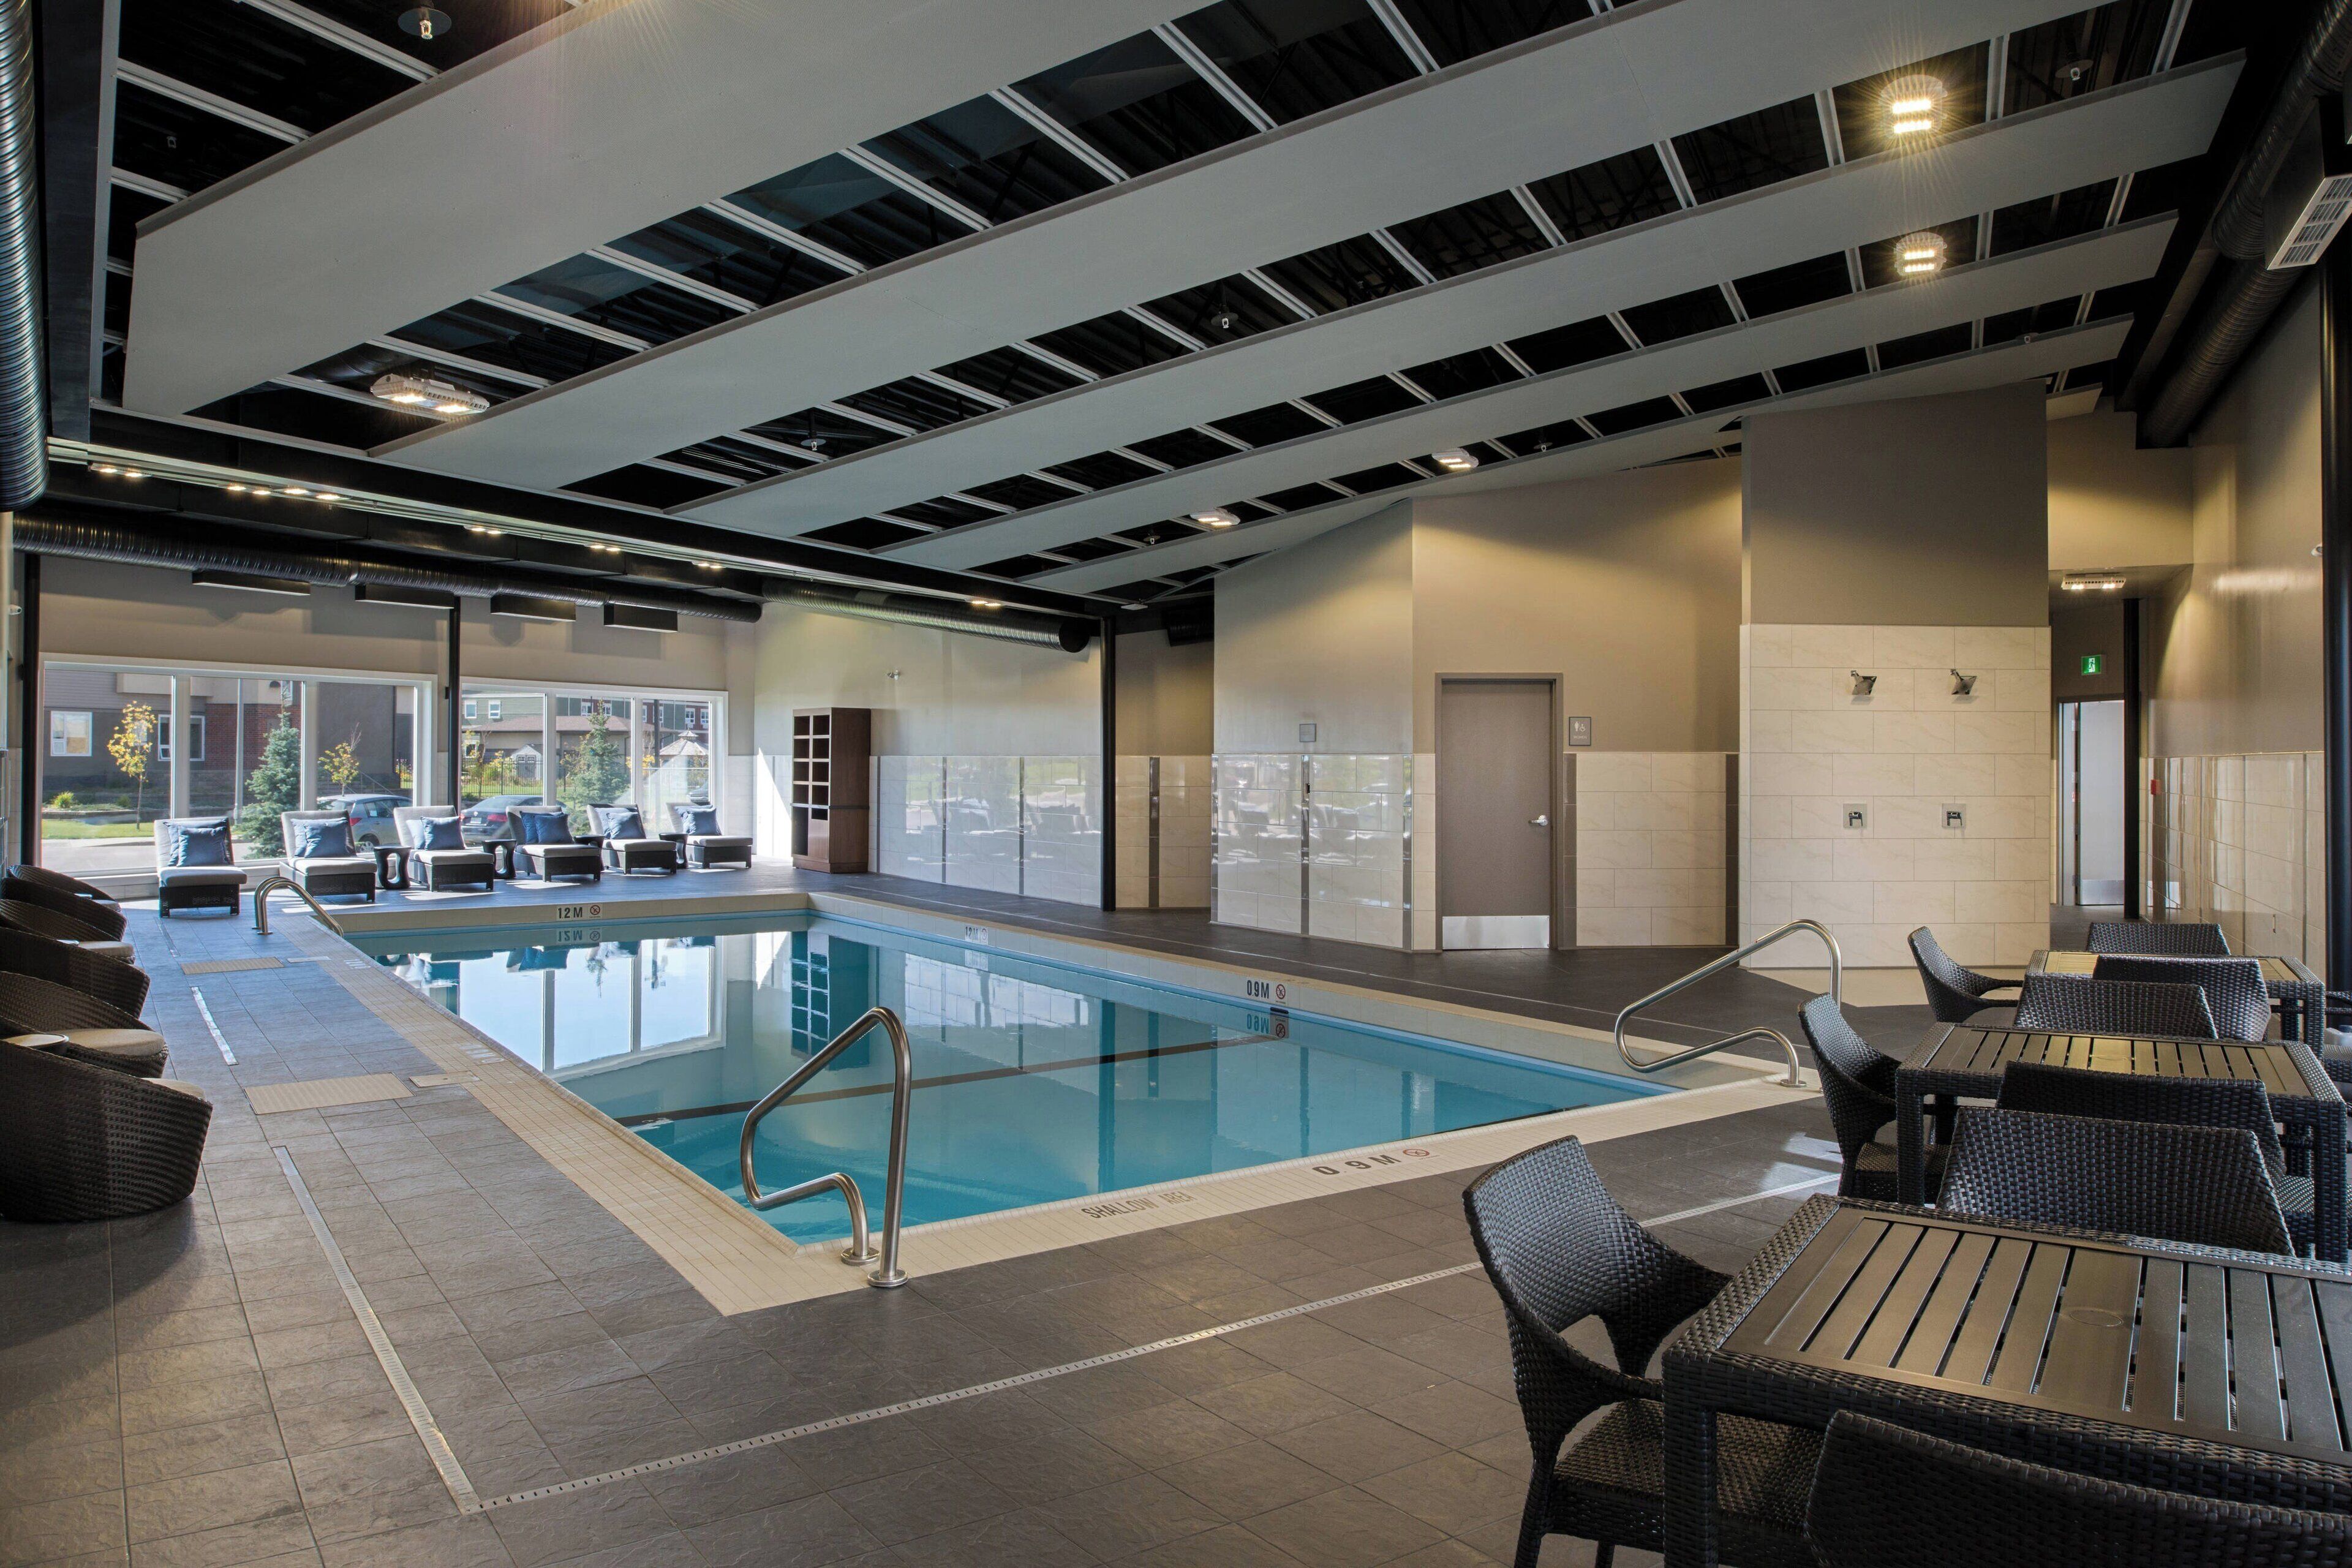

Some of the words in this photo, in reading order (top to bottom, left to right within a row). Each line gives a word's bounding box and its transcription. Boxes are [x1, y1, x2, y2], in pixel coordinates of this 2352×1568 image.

[573, 907, 582, 918] M
[1081, 1197, 1159, 1219] SHALLOW
[1158, 1191, 1197, 1205] AREA
